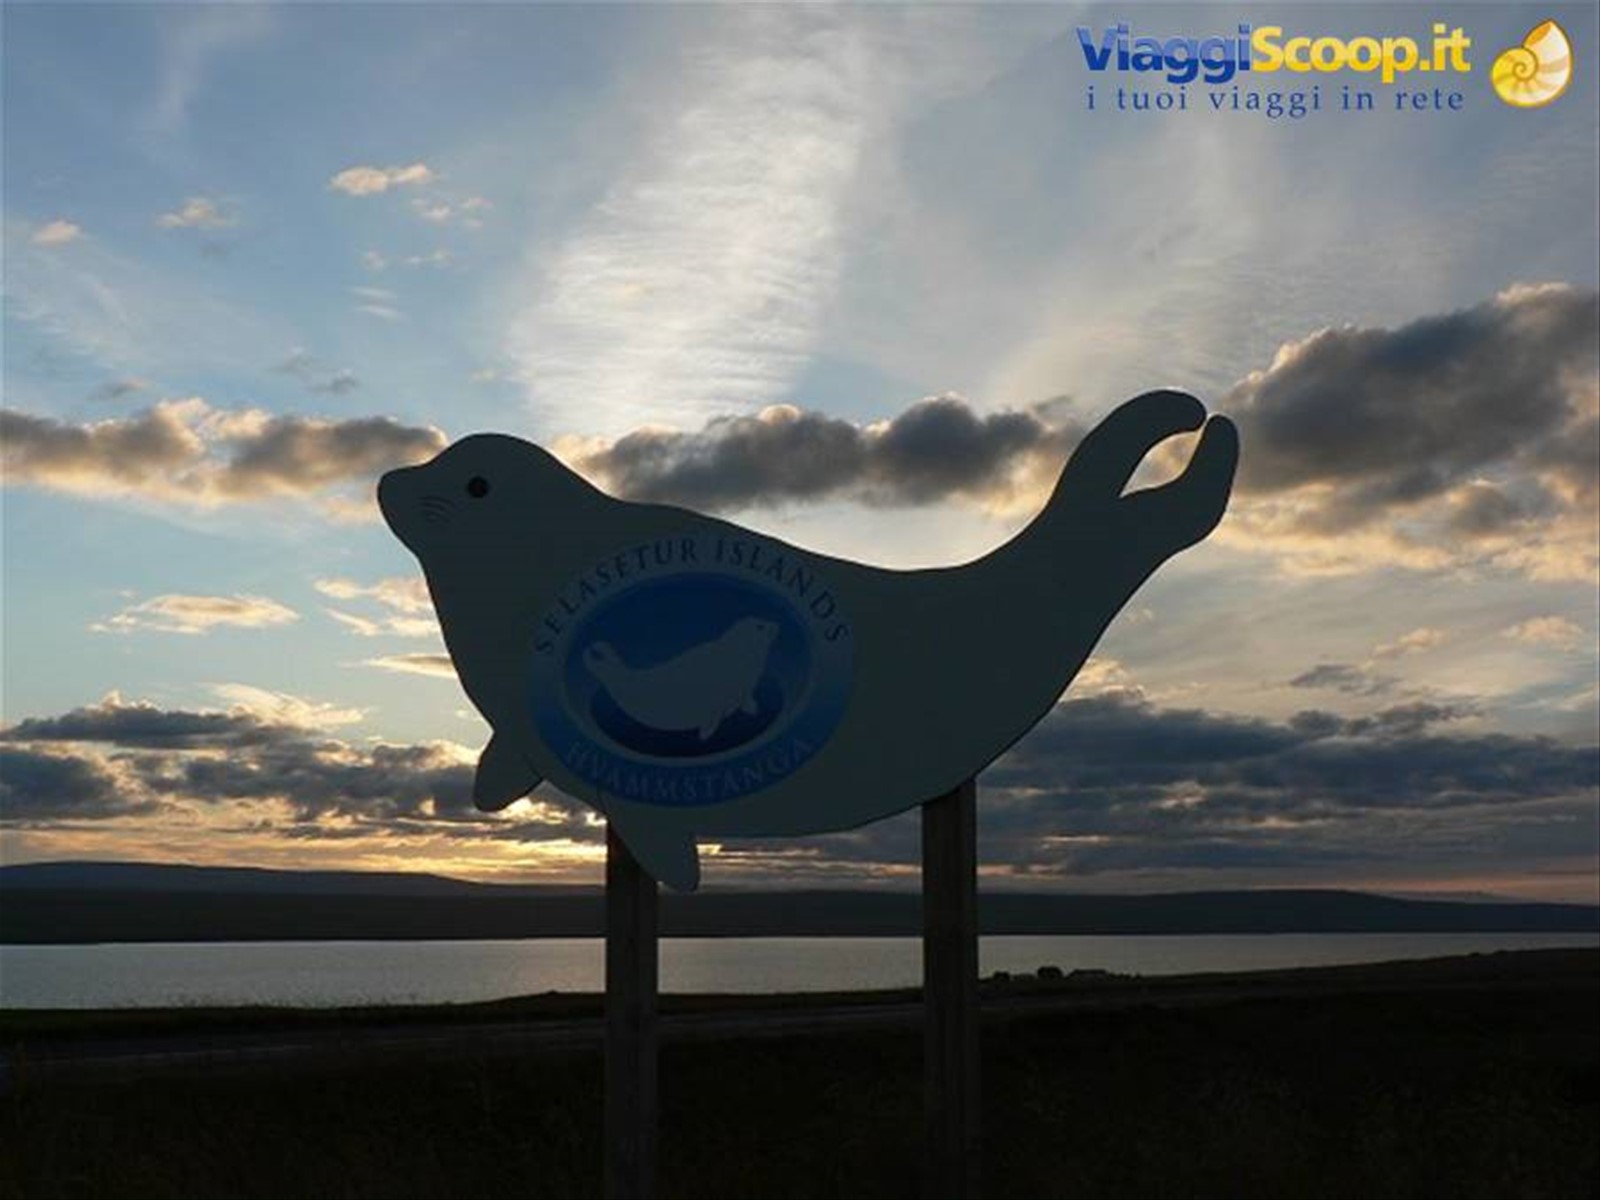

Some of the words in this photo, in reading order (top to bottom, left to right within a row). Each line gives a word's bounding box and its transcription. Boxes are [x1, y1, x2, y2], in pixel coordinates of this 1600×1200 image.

[535, 537, 699, 653] SELASETUR
[716, 538, 849, 643] ISLANDS
[565, 738, 812, 801] HVAMMSTANGA
